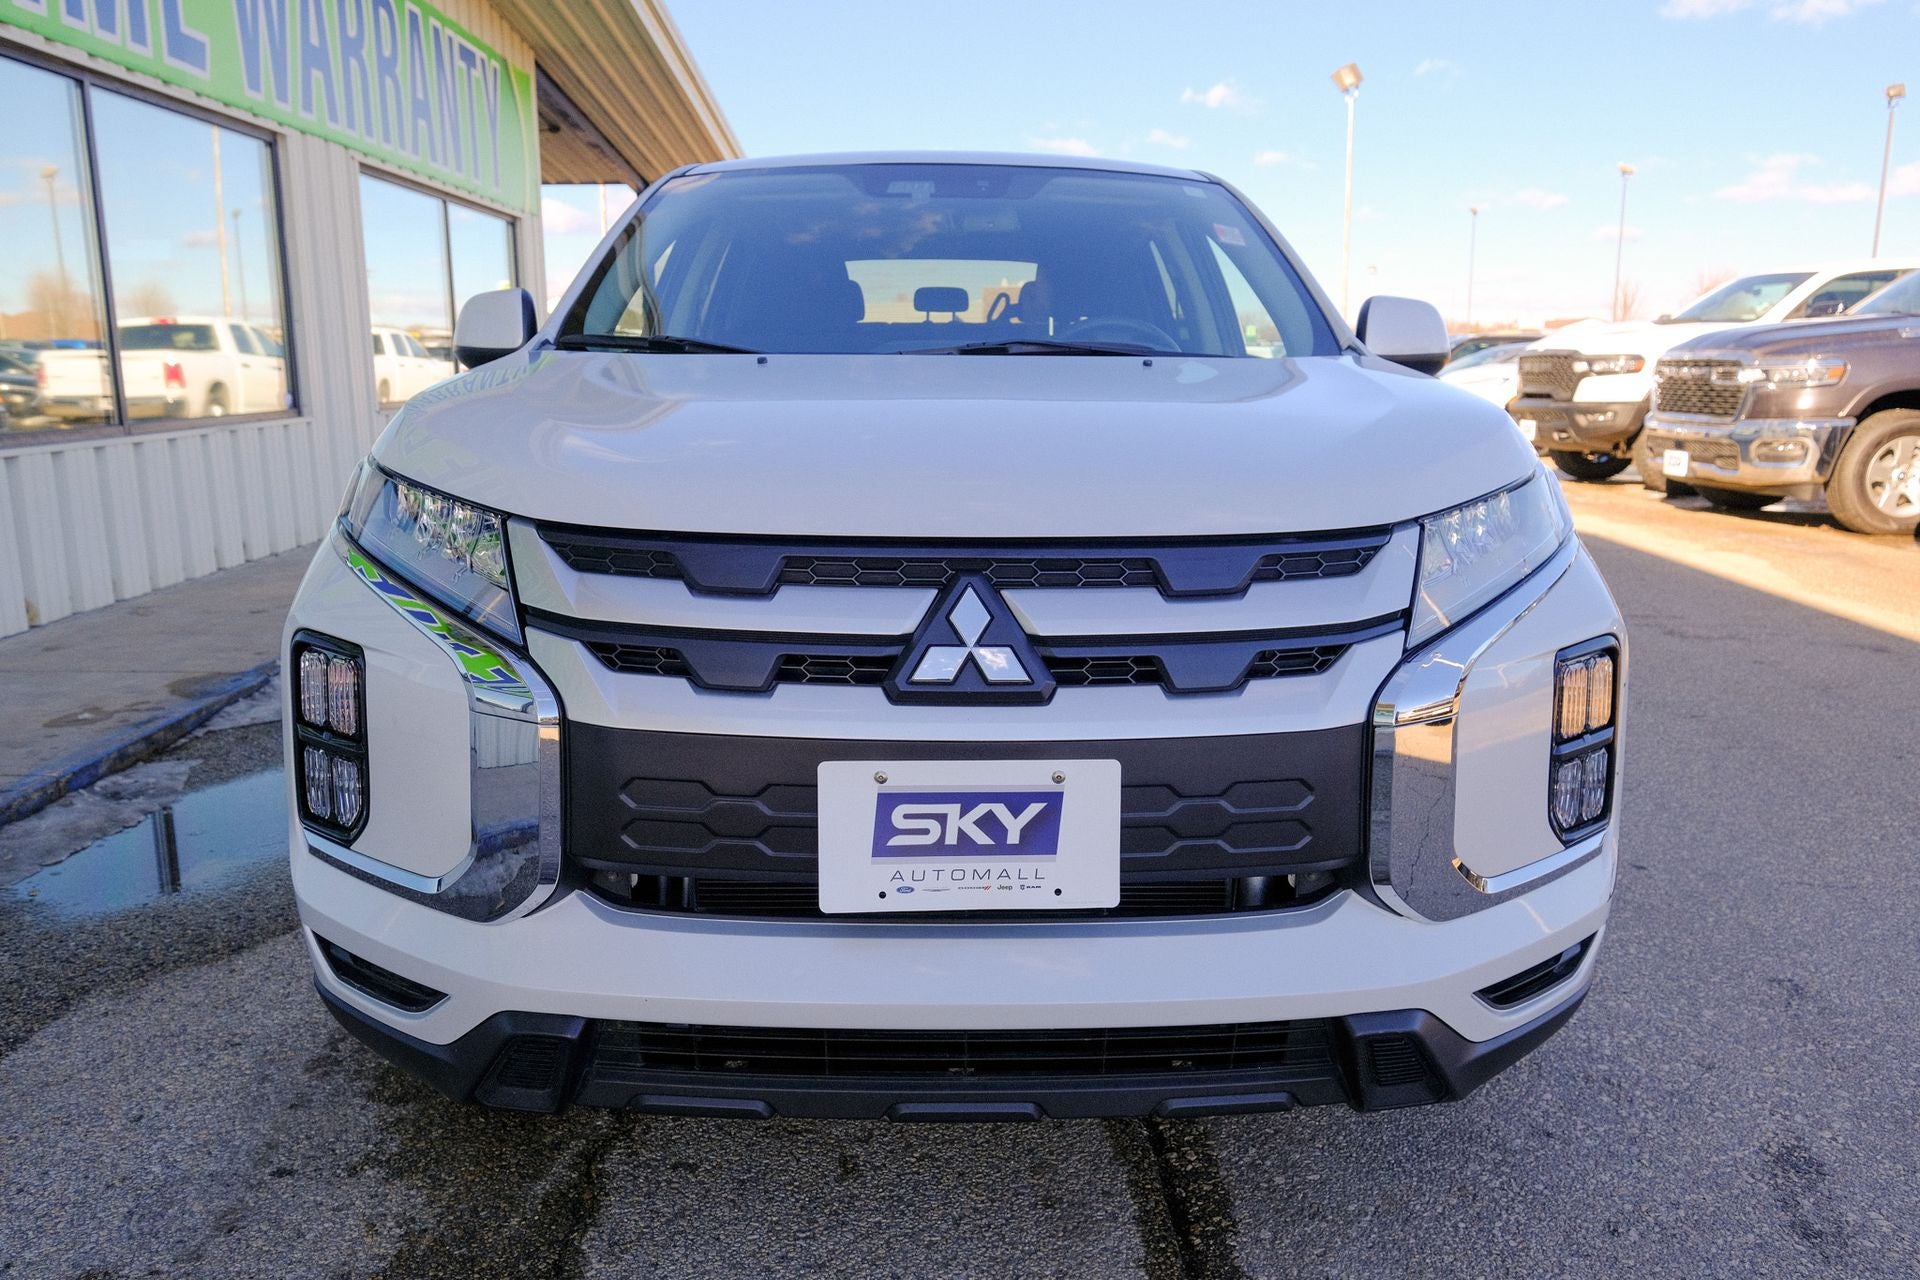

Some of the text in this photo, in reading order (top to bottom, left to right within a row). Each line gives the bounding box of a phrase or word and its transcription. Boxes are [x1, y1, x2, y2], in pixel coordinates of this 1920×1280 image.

[233, 0, 503, 192] WARRANTY
[886, 803, 1048, 846] SKY
[890, 868, 1046, 882] AUTOMALL
